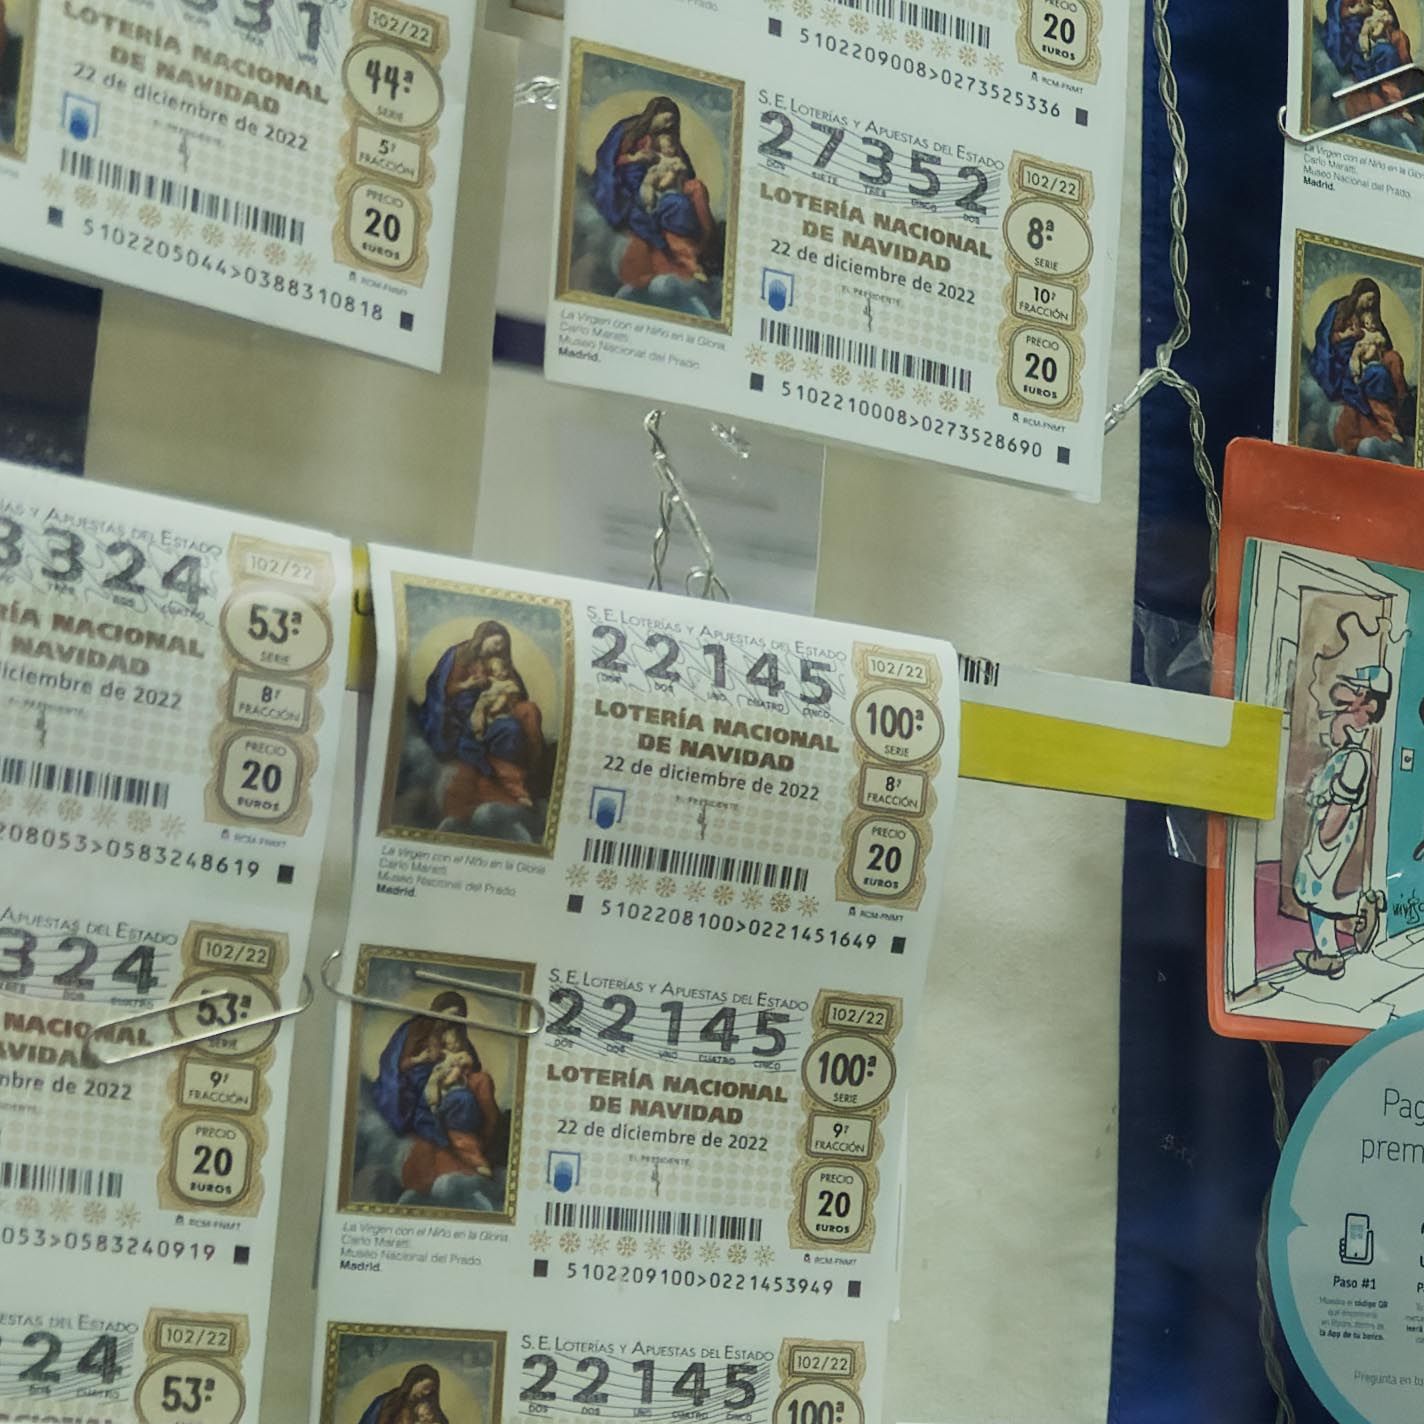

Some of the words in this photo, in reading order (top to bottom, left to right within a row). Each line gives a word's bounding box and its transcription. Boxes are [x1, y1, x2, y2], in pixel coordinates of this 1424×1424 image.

[1043, 12, 1077, 45] 20
[757, 109, 988, 218] 27352
[364, 208, 401, 242] 20
[759, 182, 864, 223] LOTERÍA
[873, 210, 992, 259] NACIONAL
[802, 220, 835, 242] DE
[842, 227, 952, 273] NAVIDAD
[770, 241, 794, 258] 22
[797, 244, 818, 262] de
[823, 250, 907, 289] diciembre
[911, 270, 932, 292] de
[937, 276, 976, 305] 2022
[1024, 352, 1058, 384] 20
[1023, 386, 1058, 400] EUROS
[590, 625, 835, 706] 22145
[240, 760, 282, 792] 20
[869, 843, 901, 873] 20
[545, 987, 791, 1058] 22145
[192, 1146, 233, 1177] 20
[818, 1190, 852, 1219] 20
[1332, 1276, 1356, 1289] Paso
[1360, 1276, 1377, 1289] #1
[519, 1353, 759, 1411] 22145
